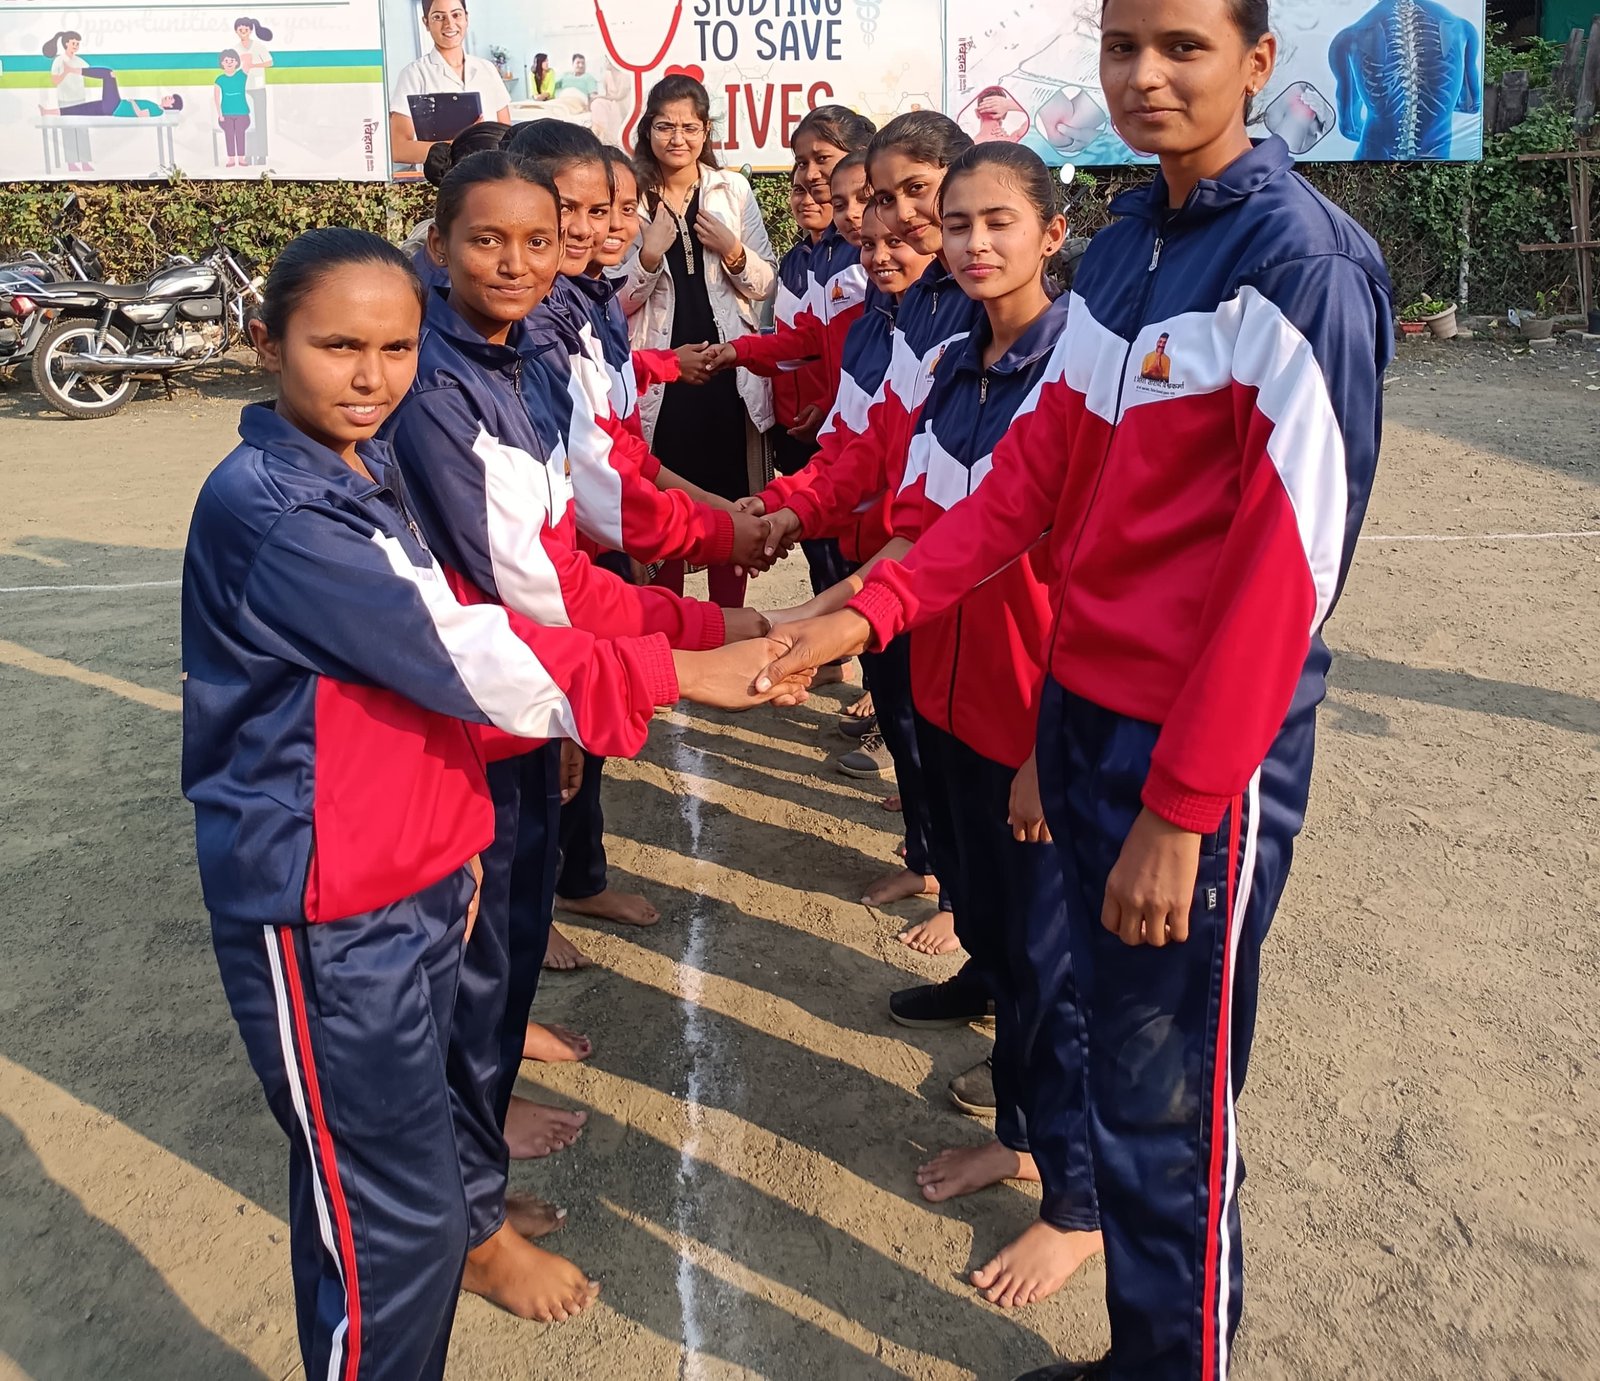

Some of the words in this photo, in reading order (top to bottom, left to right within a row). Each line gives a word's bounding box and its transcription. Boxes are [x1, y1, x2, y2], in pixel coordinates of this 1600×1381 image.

[60, 9, 230, 47] Opportunities
[694, 20, 738, 61] TO
[755, 19, 842, 61] SAVE
[711, 81, 834, 150] IVE
